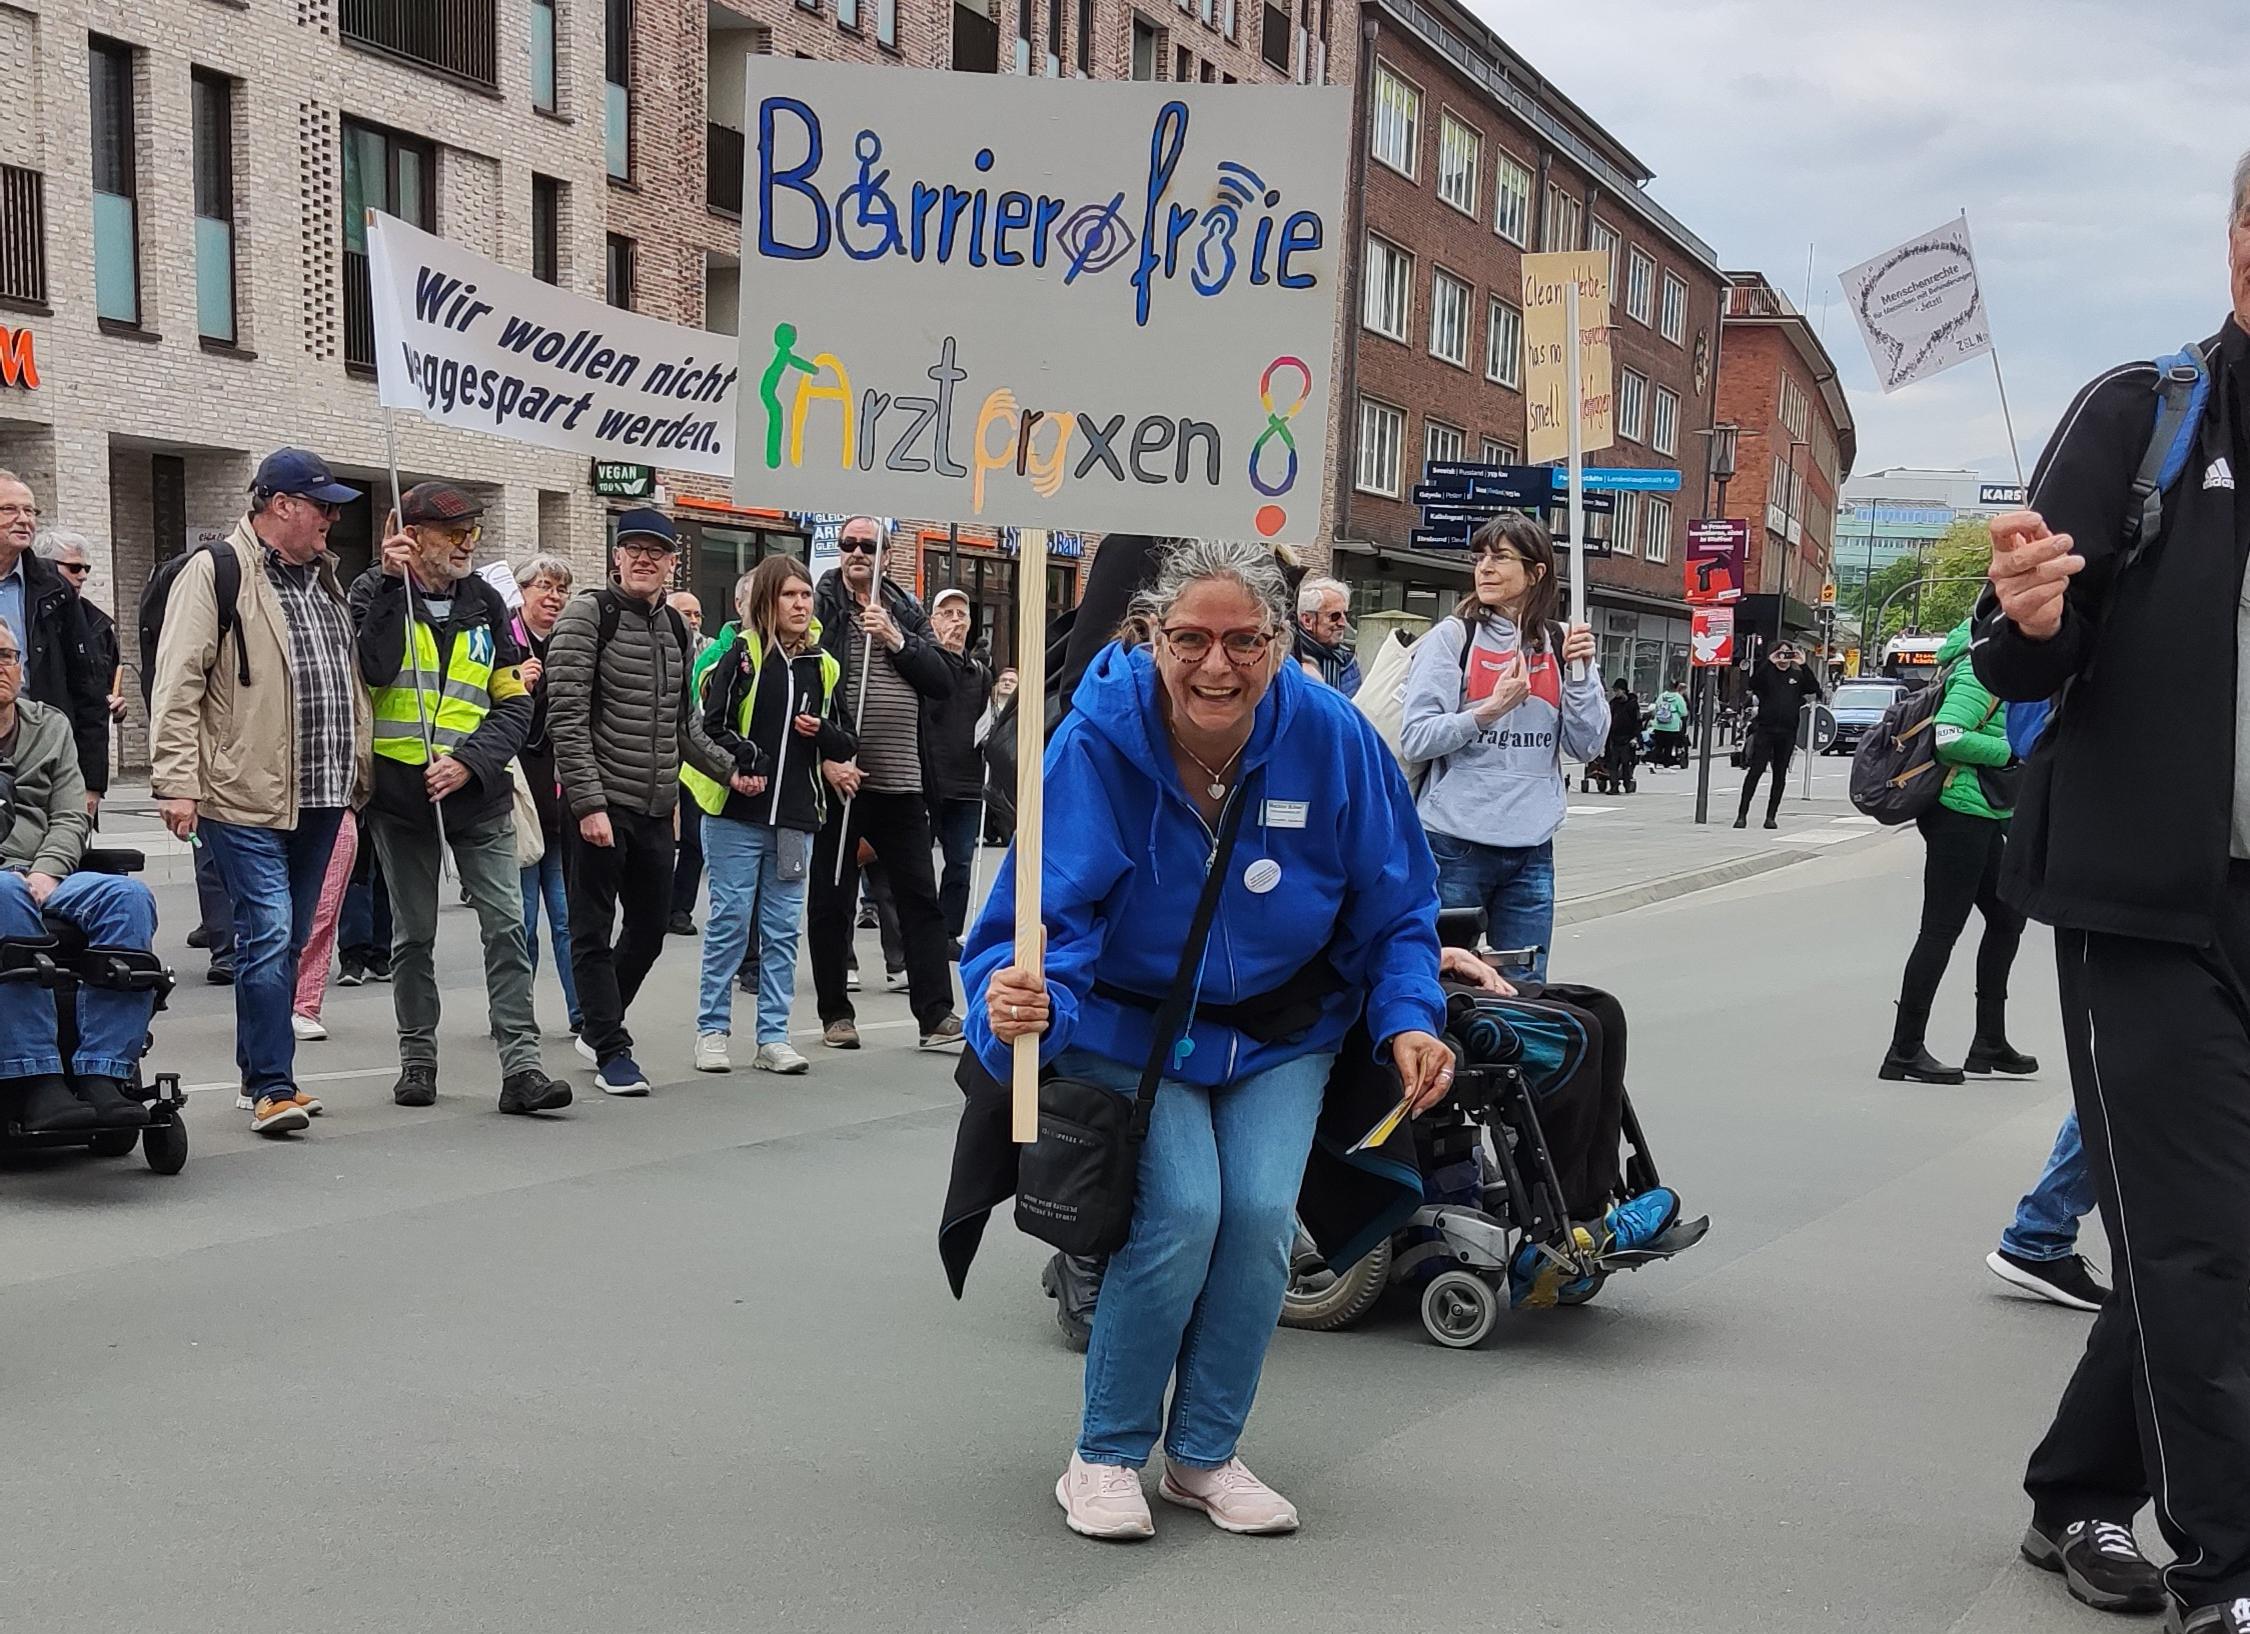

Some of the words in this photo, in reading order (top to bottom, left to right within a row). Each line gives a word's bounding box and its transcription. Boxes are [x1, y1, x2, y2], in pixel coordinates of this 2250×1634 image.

[1525, 273, 1562, 308] Clean
[1880, 264, 1960, 305] Menschenrechte
[415, 265, 494, 332] Wir
[497, 315, 640, 387] wollen
[640, 356, 738, 404] nicht
[1527, 333, 1546, 369] has
[1549, 343, 1562, 365] no
[594, 407, 721, 455] werden.
[598, 465, 637, 480] VEGAN
[1475, 728, 1552, 750] ragance
